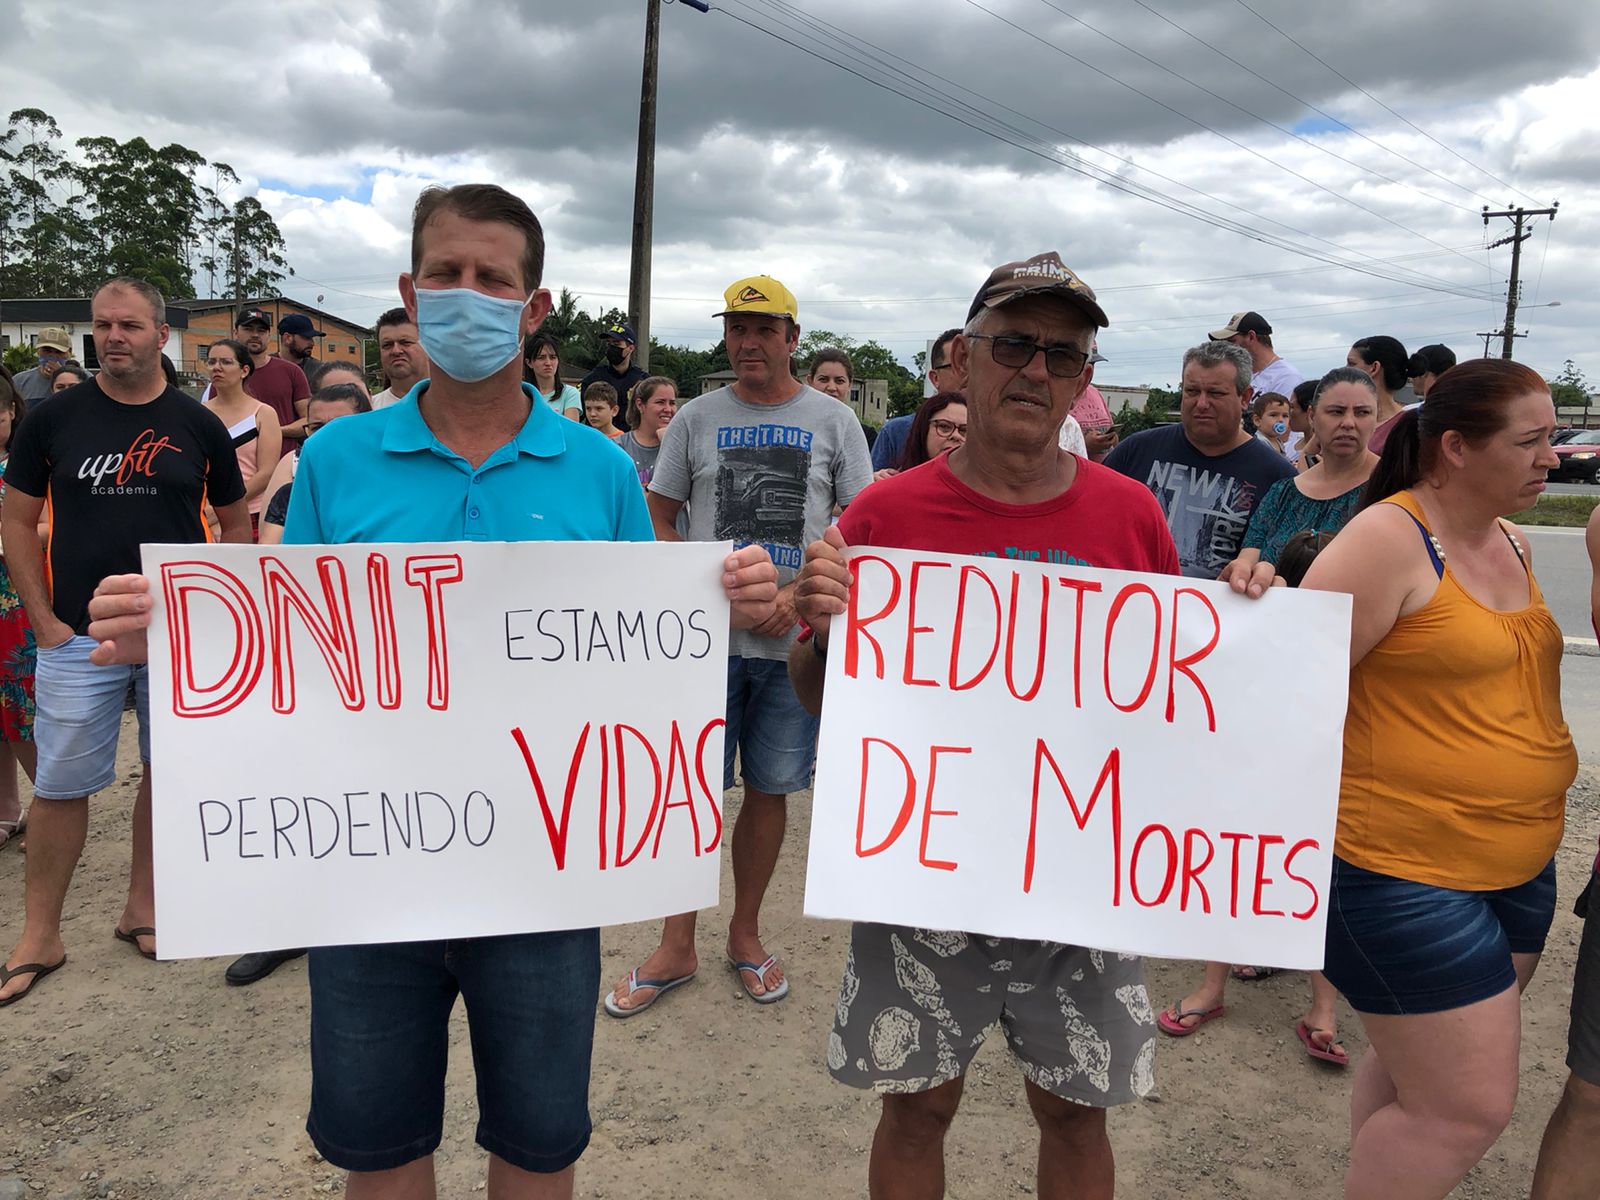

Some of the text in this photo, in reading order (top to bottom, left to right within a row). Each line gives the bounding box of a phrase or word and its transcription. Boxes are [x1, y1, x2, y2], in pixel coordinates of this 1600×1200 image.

[91, 486, 158, 495] academia
[718, 426, 810, 449] THE TRUE
[1146, 459, 1222, 498] NEW
[1207, 477, 1250, 568] YORK
[160, 552, 711, 719] DNIT ESTAMOS
[843, 554, 1221, 733] REDUTOR
[198, 718, 727, 871] PERDENDO VIDAS
[855, 736, 1321, 920] DE MORTES
